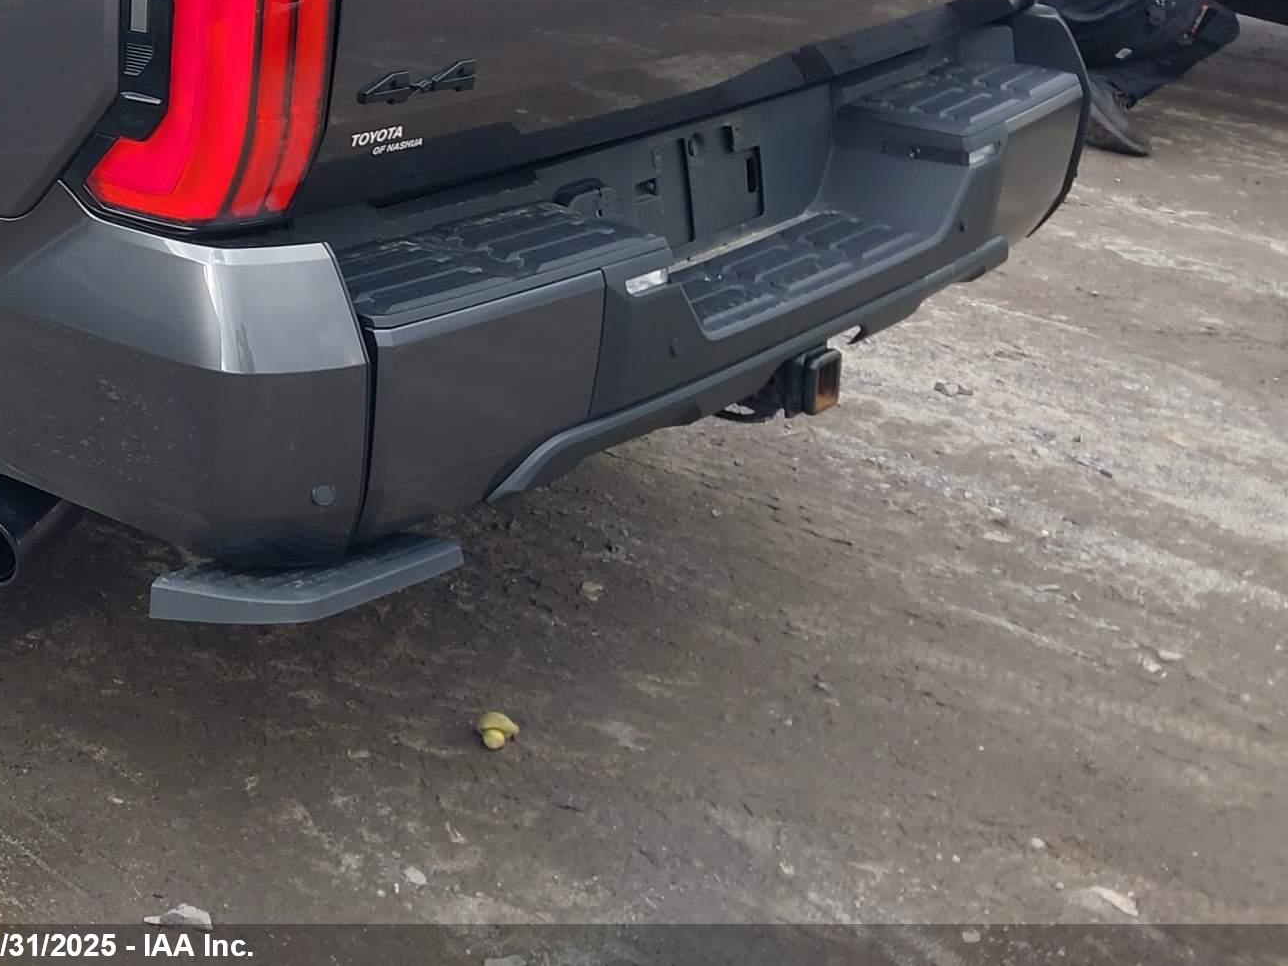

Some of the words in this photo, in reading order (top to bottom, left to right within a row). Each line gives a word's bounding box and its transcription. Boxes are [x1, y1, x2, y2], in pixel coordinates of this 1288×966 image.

[350, 125, 404, 148] TOYOTA
[372, 144, 387, 156] OF
[386, 137, 424, 153] NASHUA
